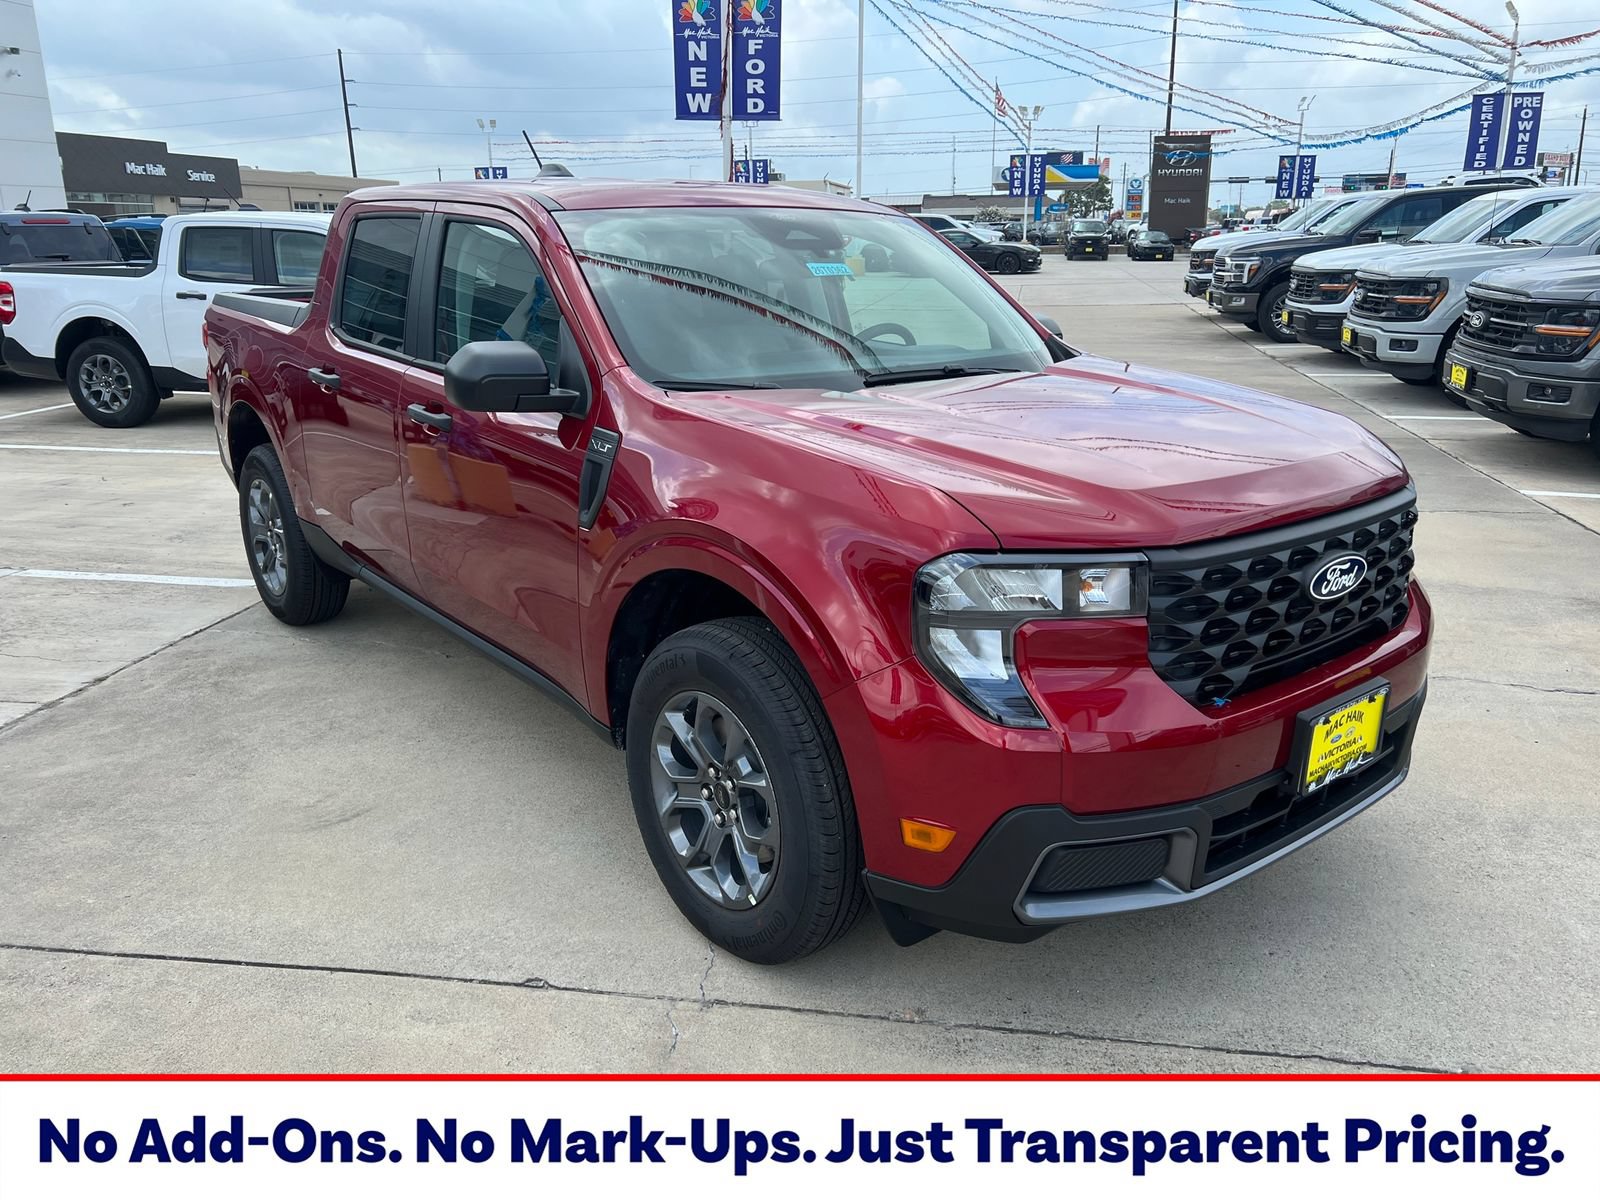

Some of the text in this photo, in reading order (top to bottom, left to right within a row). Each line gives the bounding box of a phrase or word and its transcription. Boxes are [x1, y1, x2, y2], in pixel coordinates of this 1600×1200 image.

[686, 41, 712, 113] NEW
[745, 39, 766, 113] FORD
[1513, 96, 1541, 108] PRE
[1473, 97, 1494, 168] CERTIFIED
[1513, 109, 1534, 166] OWNED
[125, 162, 168, 177] Mac Haik
[186, 169, 216, 183] Service
[1012, 171, 1023, 196] NEW
[1033, 156, 1042, 195] HYUNDAI
[1157, 168, 1203, 177] HYUNDAI
[1301, 157, 1313, 197] HYUNDAI
[1279, 172, 1291, 198] NEW
[591, 439, 613, 453] XLT
[1320, 562, 1359, 595] Ford
[1324, 714, 1346, 743] MAC
[1345, 710, 1365, 725] HAIK
[1324, 737, 1357, 760] VICTORIA
